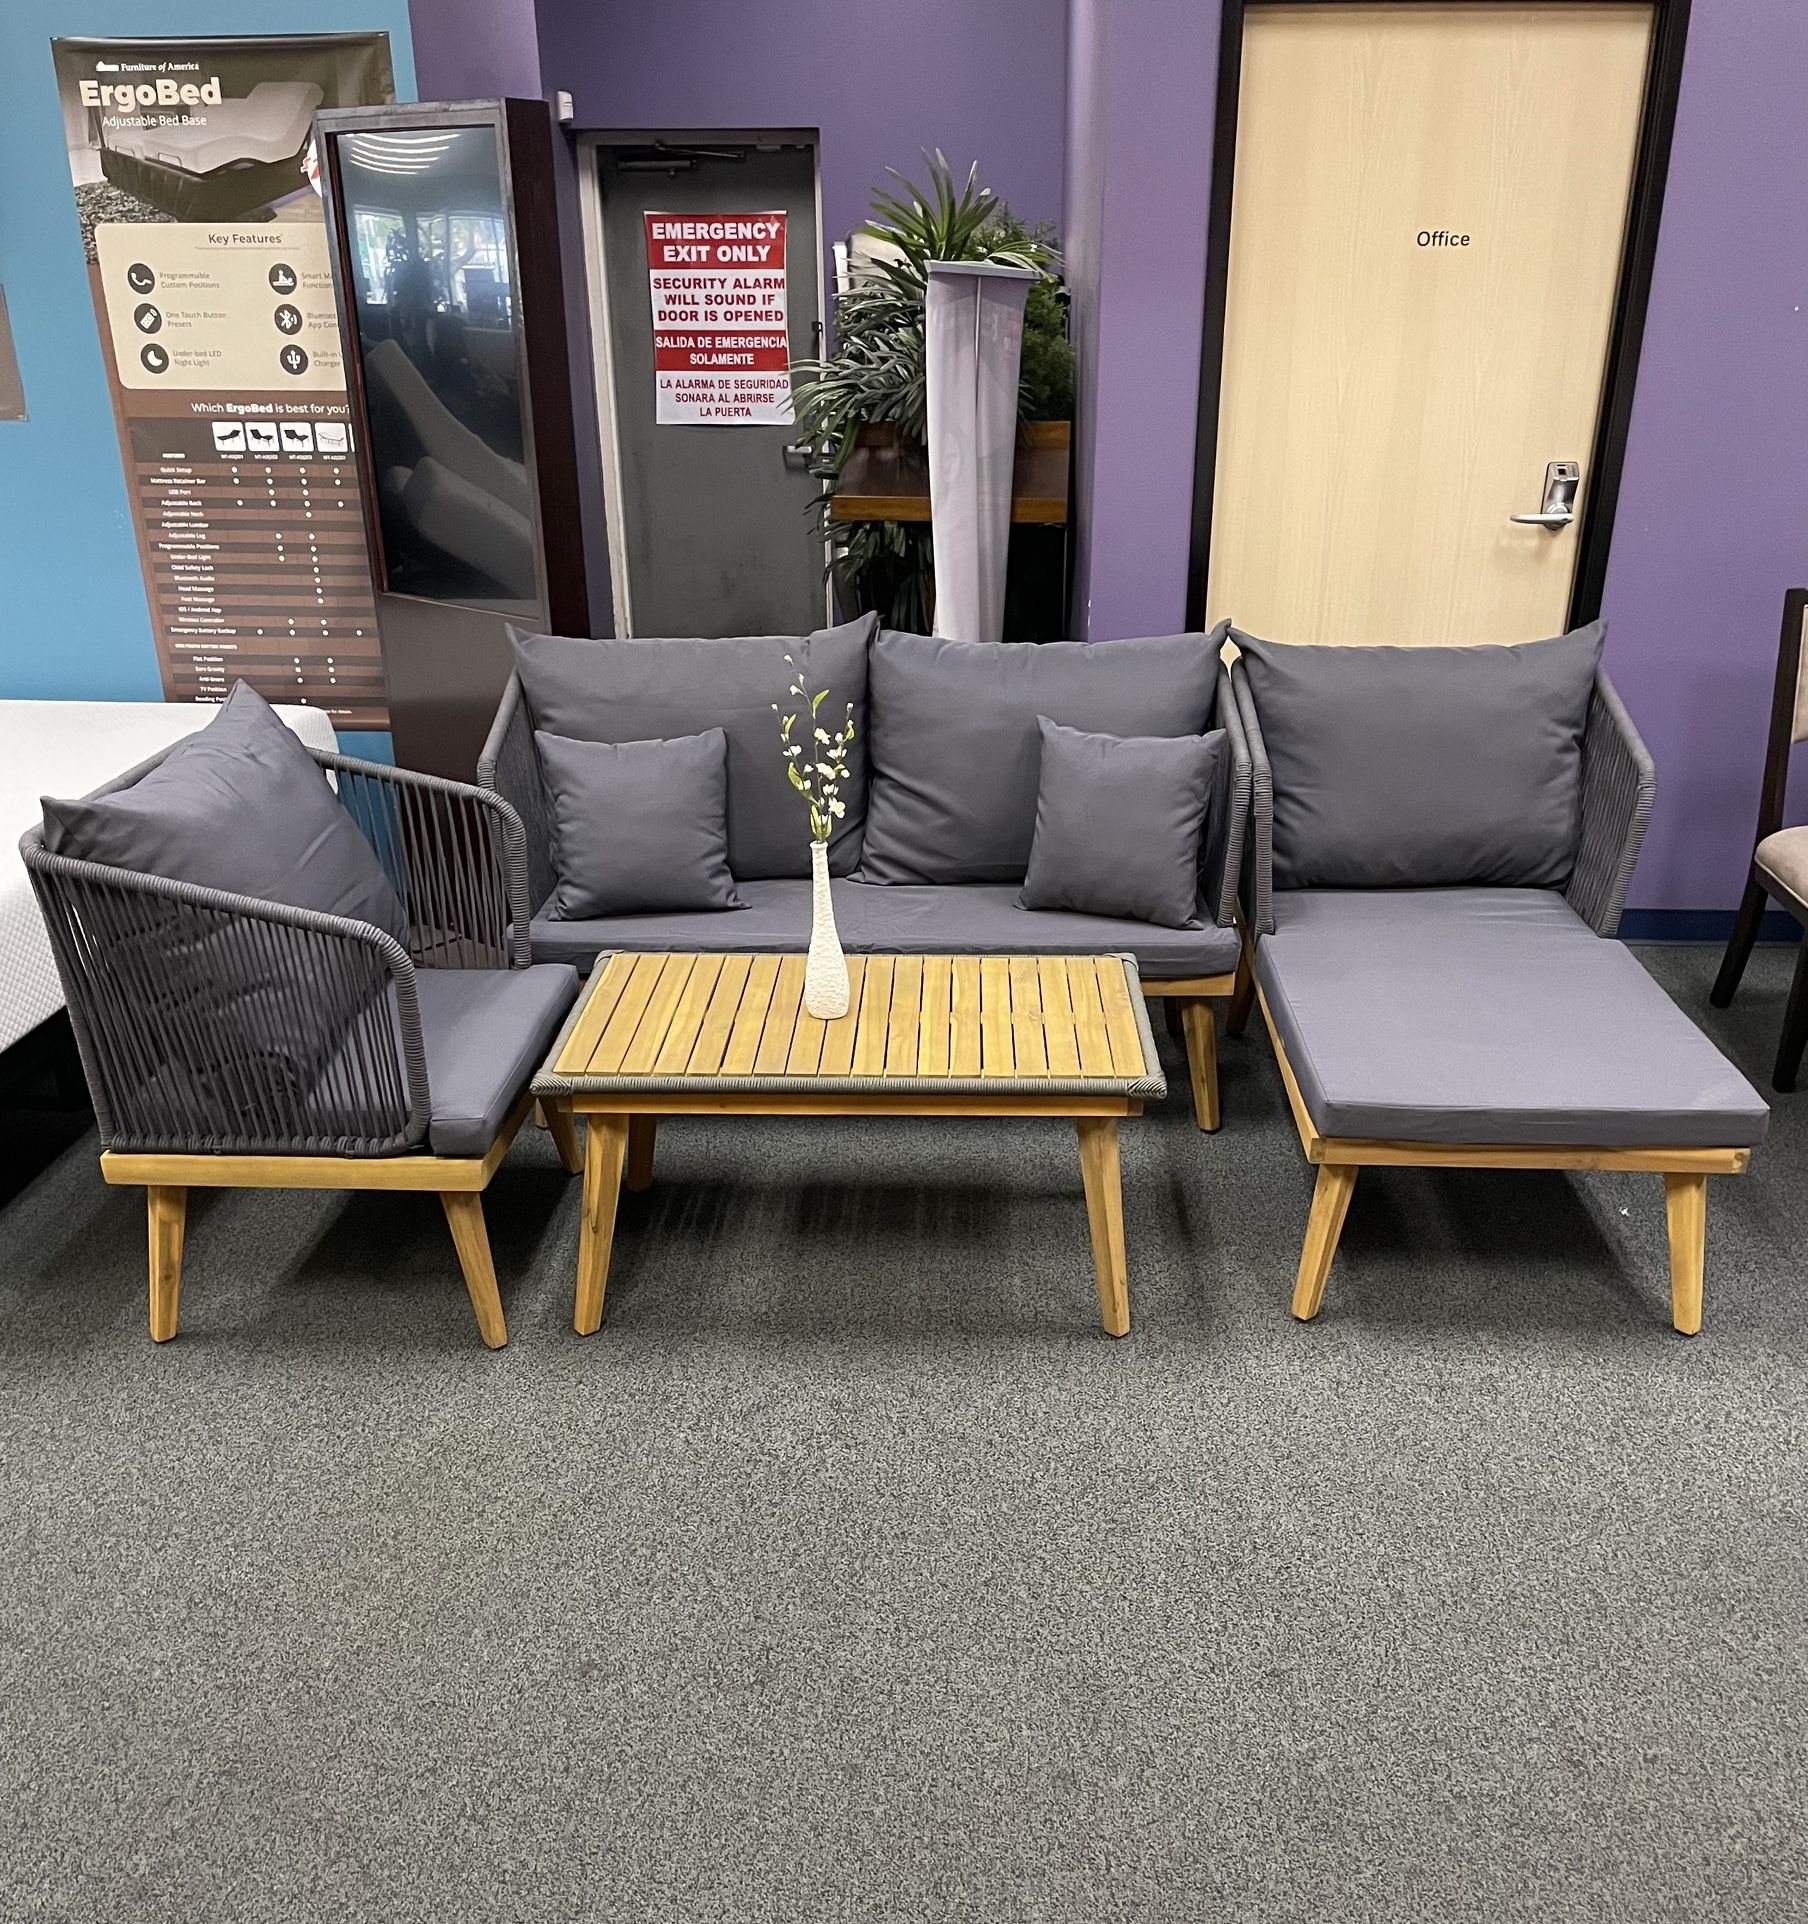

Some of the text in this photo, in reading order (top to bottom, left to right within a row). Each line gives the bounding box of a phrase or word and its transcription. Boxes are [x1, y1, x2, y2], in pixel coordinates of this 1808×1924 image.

[121, 61, 200, 73] Furniture of America
[79, 77, 222, 112] ErgoBed
[103, 115, 207, 129] Adjustable Bed Base
[652, 222, 780, 240] EMERGENCY
[208, 233, 283, 246] Key Features
[1417, 231, 1470, 246] Office
[663, 245, 771, 262] EXIT ONLY
[160, 272, 210, 280] Programmable
[301, 272, 322, 280] Smart
[161, 281, 220, 289] Custom Positions
[653, 278, 785, 289] SECURITY ALARM
[664, 294, 776, 306] WILL SOUND IF
[307, 312, 337, 320] Bluetoot
[658, 310, 784, 322] DOOR IS OPENED
[309, 321, 323, 330] App
[655, 336, 788, 348] SALIDA DE EMERGENCIA
[174, 359, 210, 368] Night Light
[690, 353, 755, 365] SOLAMENTE
[660, 379, 789, 390] LA ALARMA DE SEGURIDAD
[675, 393, 775, 404] SONARA AL ABRIRSE
[191, 402, 224, 413] Which
[226, 403, 273, 415] ErgoBed
[275, 403, 284, 413] is
[286, 404, 309, 414] best
[310, 404, 325, 414] for
[700, 407, 752, 418] LA PUERTA
